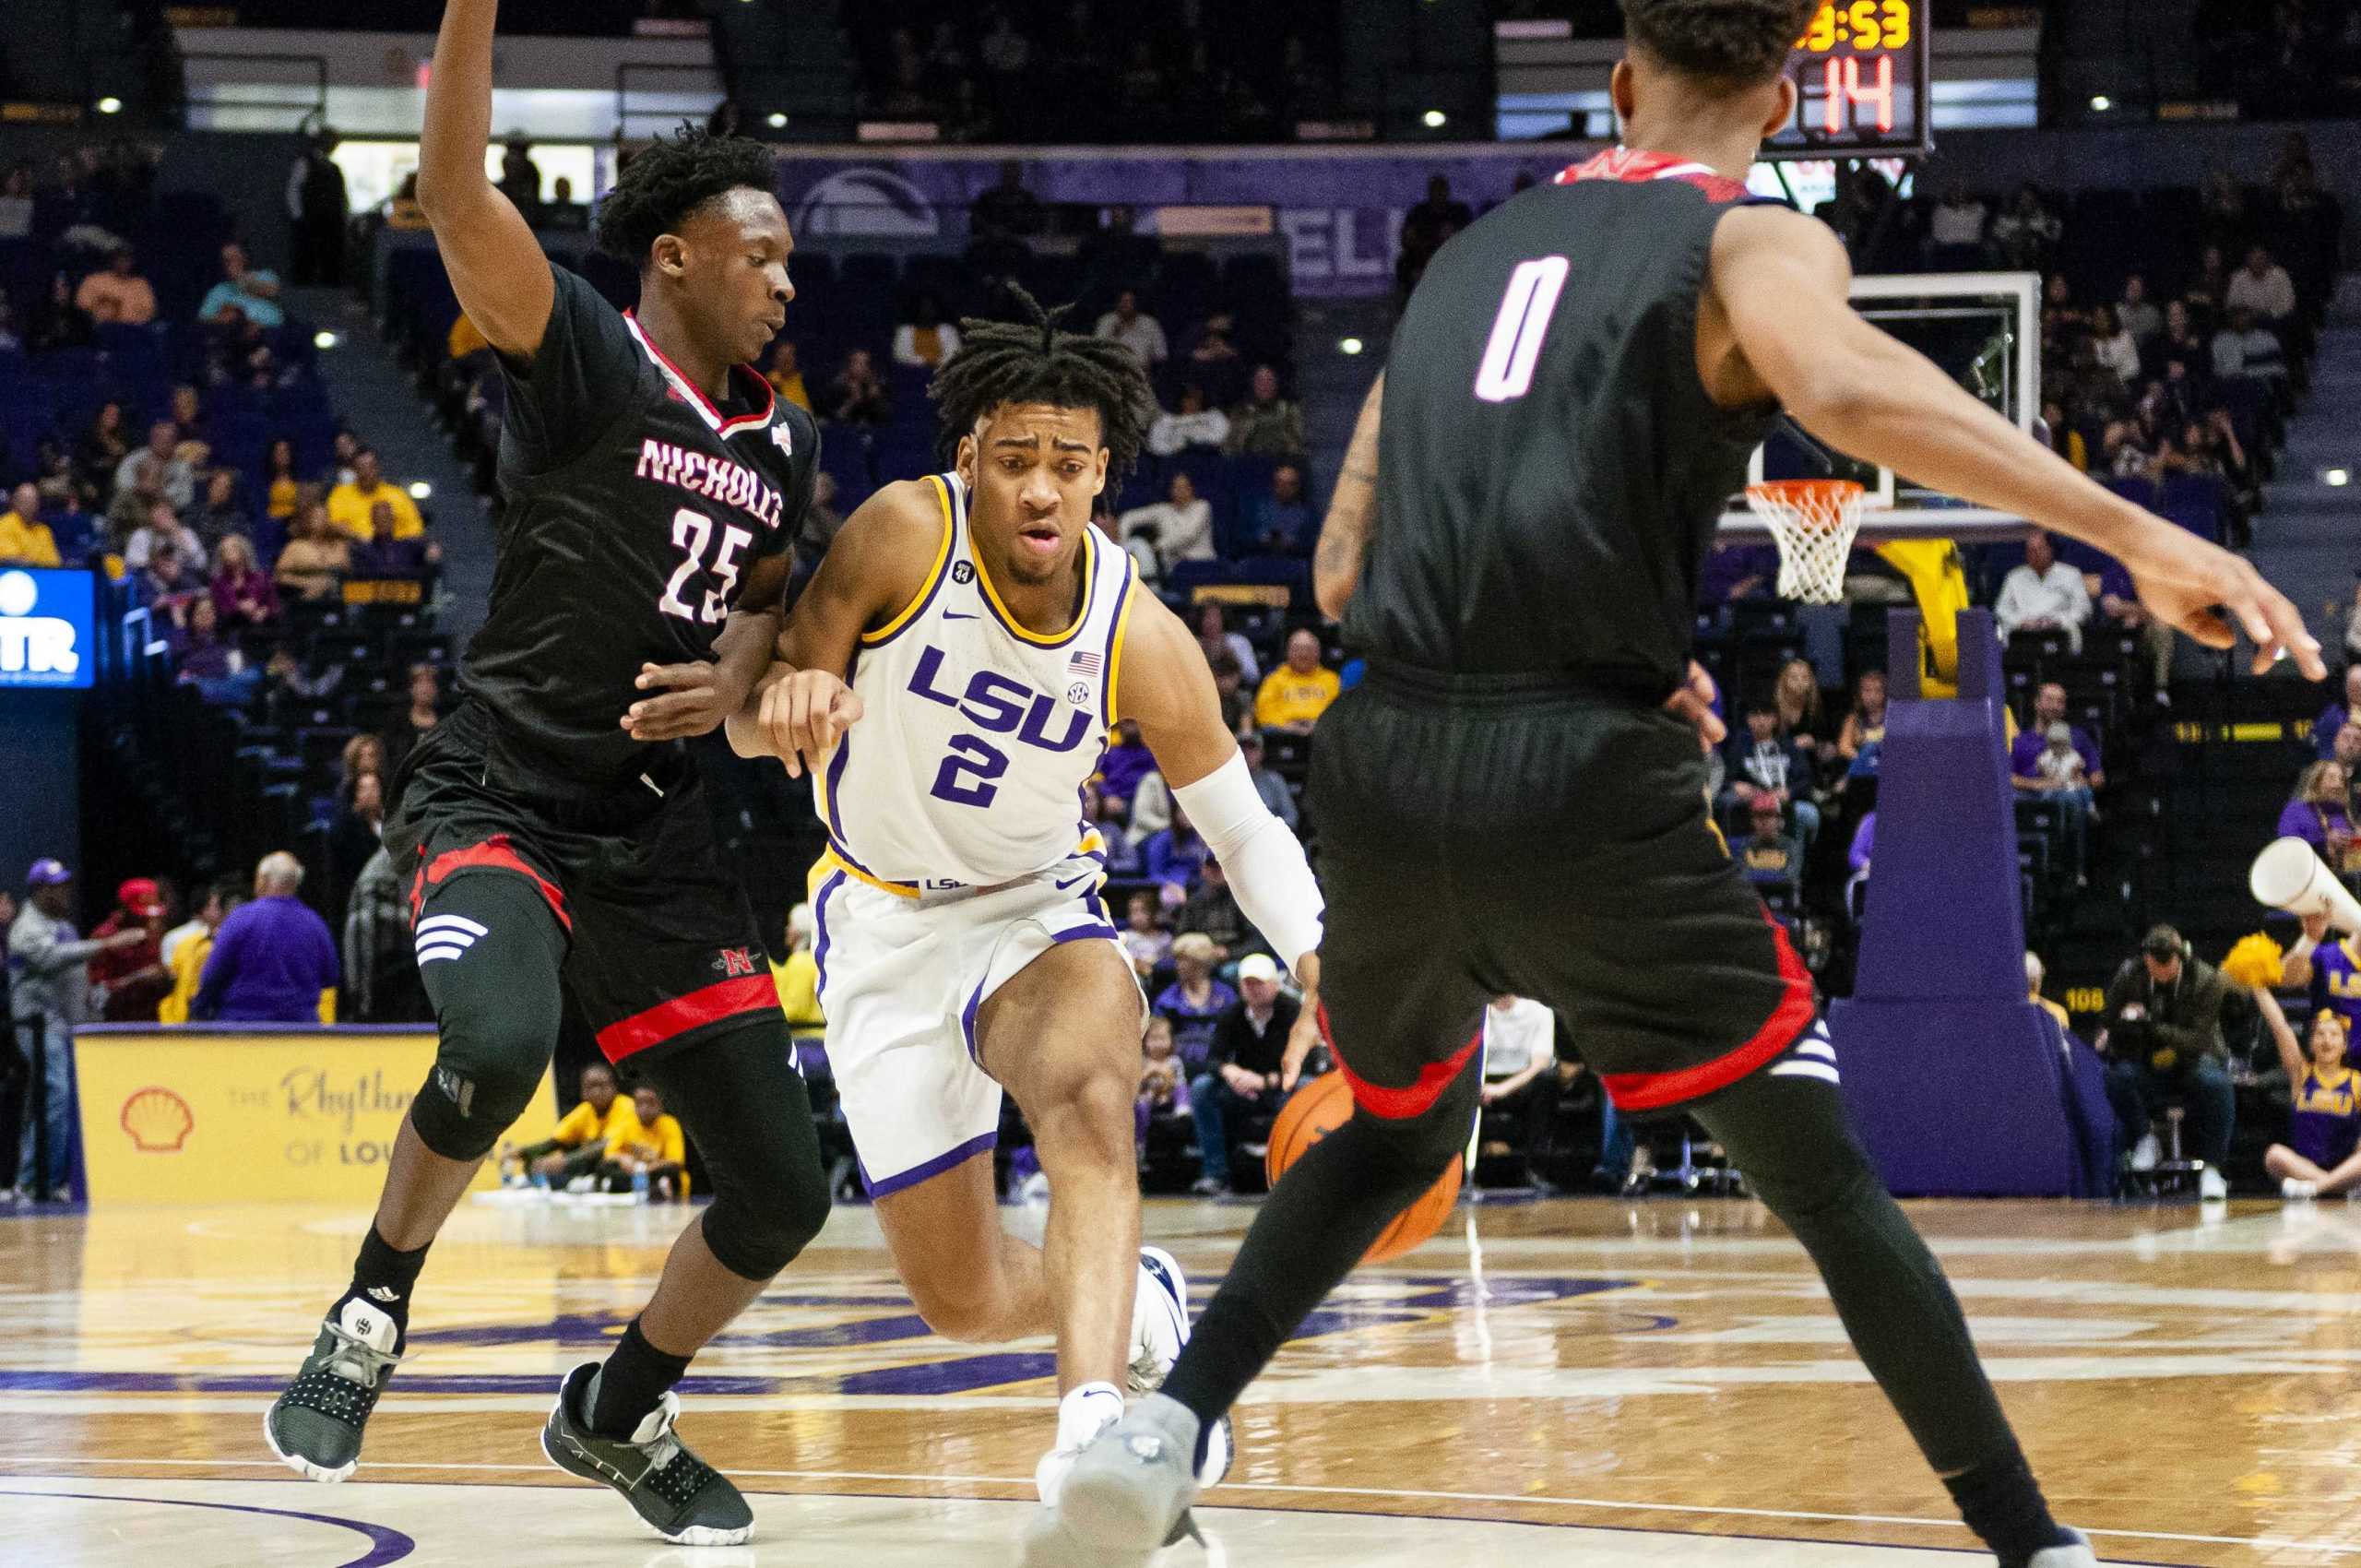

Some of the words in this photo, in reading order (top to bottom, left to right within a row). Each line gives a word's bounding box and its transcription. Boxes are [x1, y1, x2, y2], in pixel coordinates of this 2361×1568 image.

[1794, 0, 1910, 52] 3:53
[1823, 54, 1892, 134] 14
[1474, 255, 1571, 401] 0
[635, 437, 784, 531] NICHOLLS
[658, 507, 753, 624] 25
[907, 644, 1094, 753] LSU
[930, 733, 1010, 809] 2
